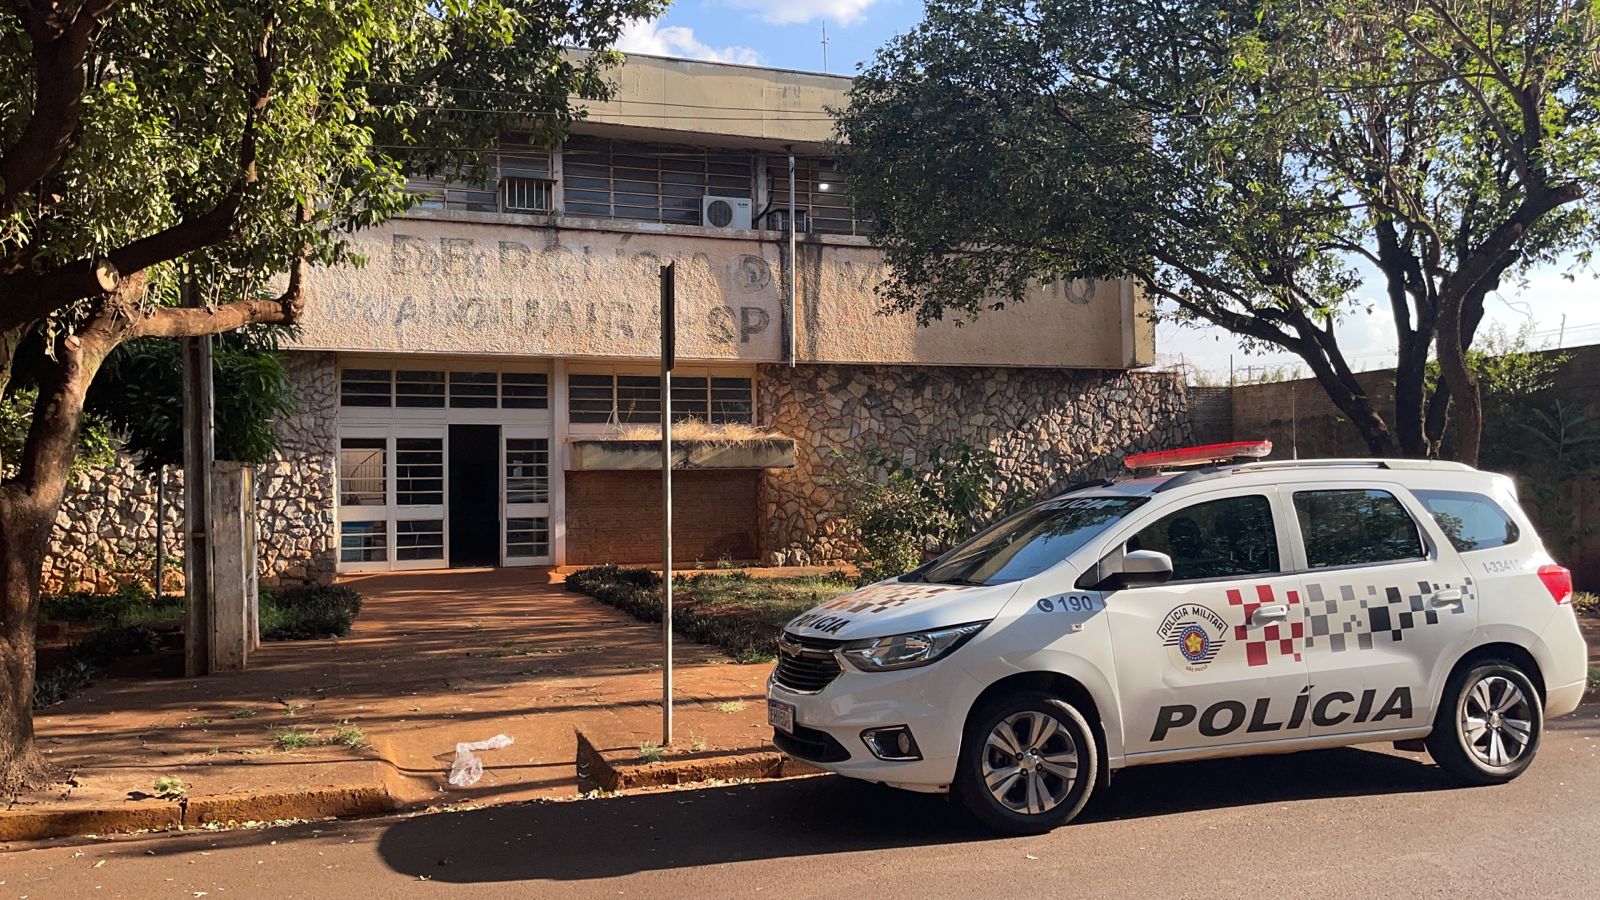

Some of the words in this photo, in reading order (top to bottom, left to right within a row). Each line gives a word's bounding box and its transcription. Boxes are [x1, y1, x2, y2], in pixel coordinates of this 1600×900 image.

[1058, 595, 1093, 611] 190
[1192, 606, 1224, 631] MILITAR
[1149, 685, 1413, 742] POLÍCIA
